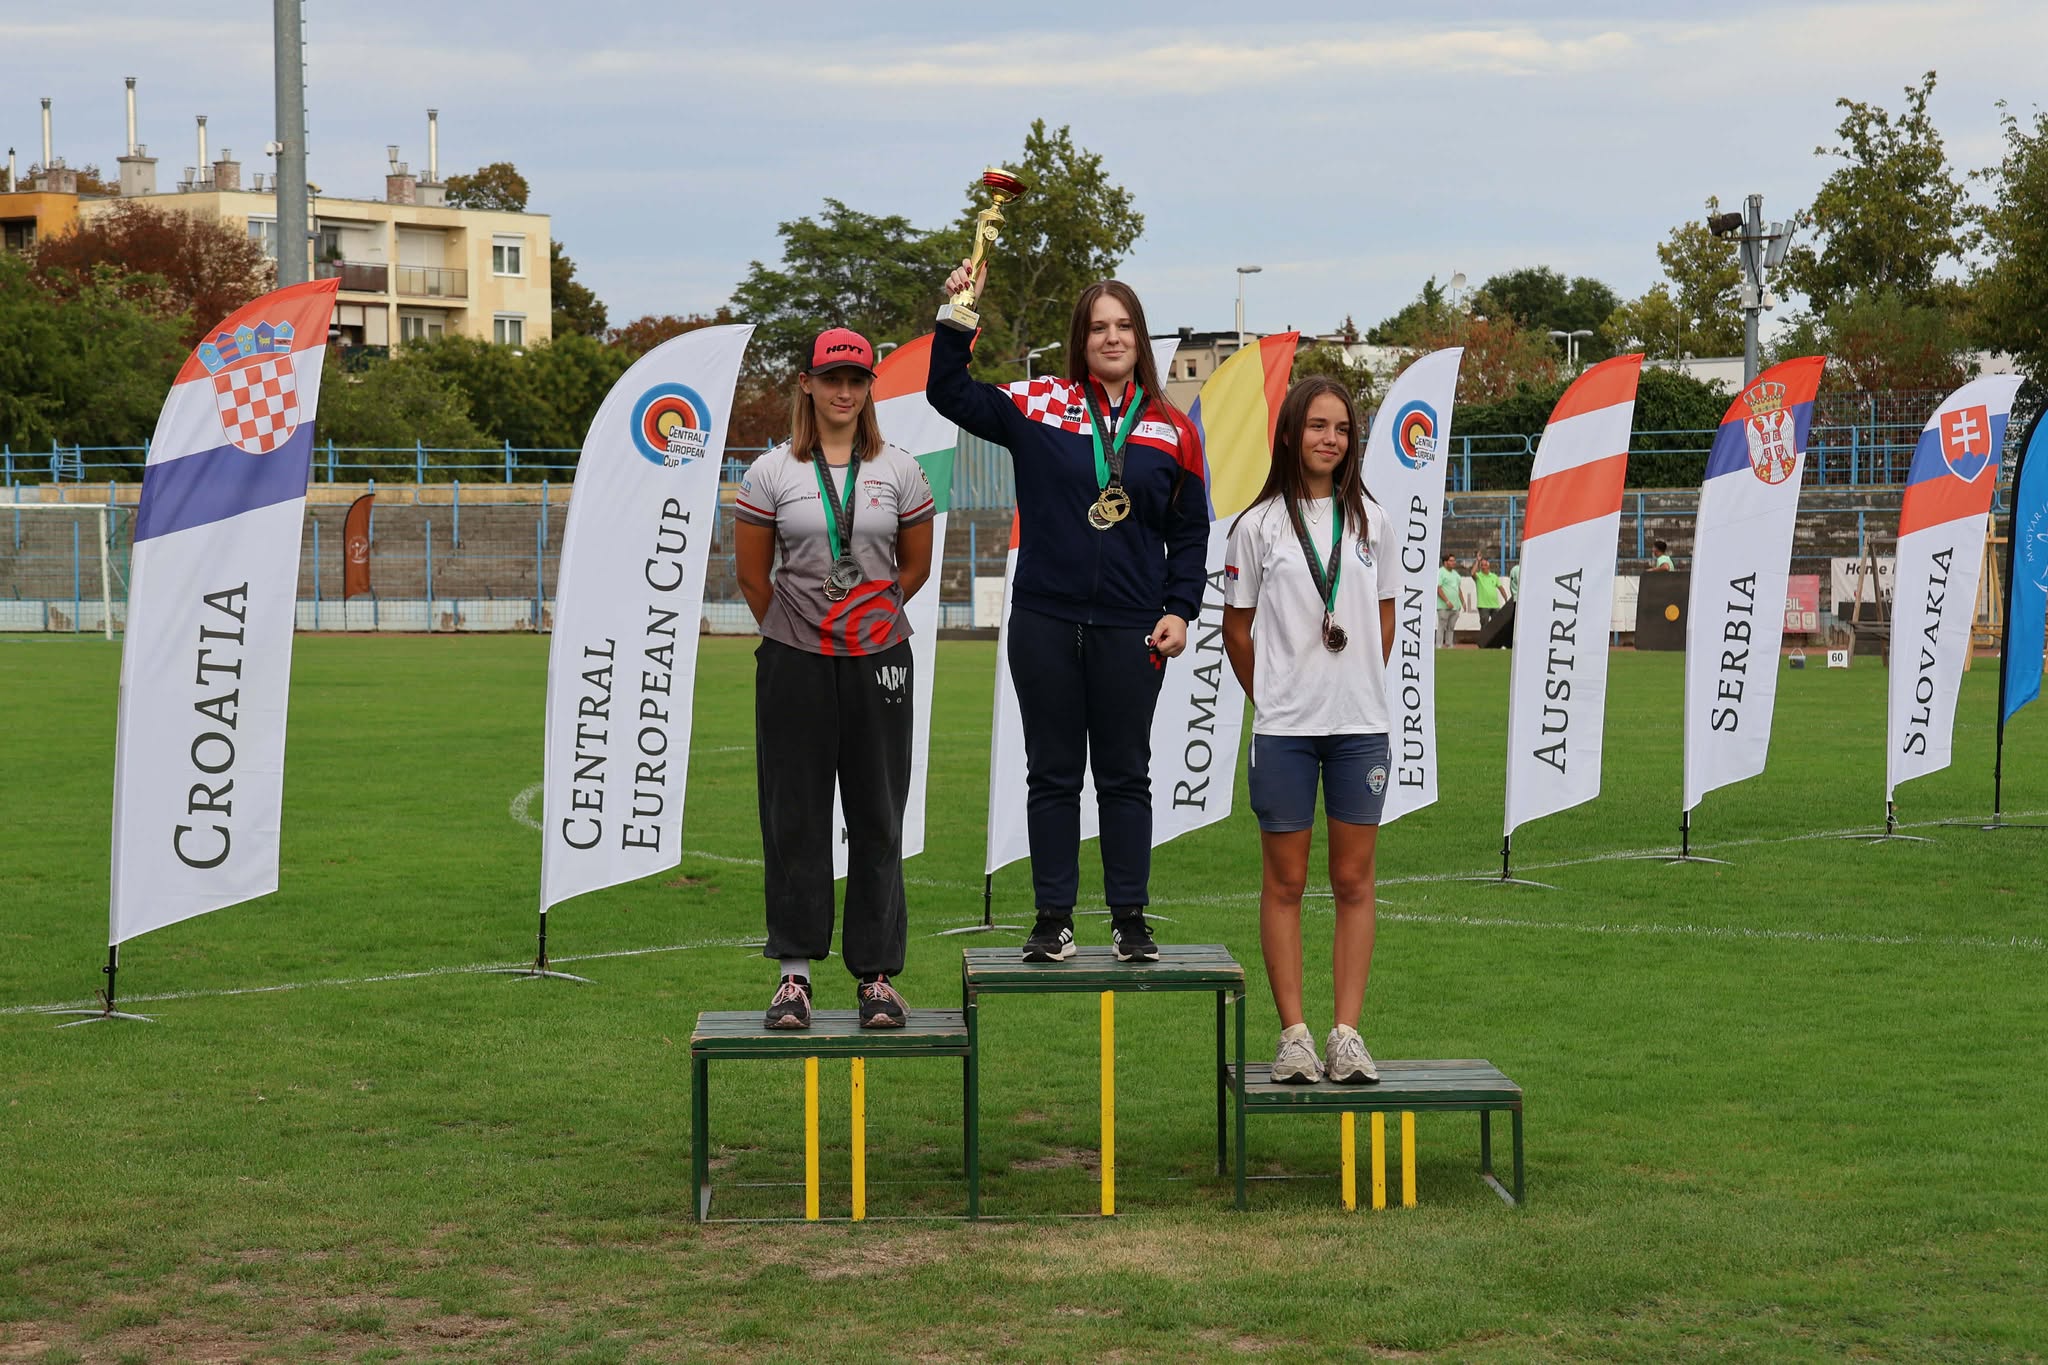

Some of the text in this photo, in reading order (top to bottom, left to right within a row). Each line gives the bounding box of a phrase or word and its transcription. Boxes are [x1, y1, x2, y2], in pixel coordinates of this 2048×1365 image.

[669, 425, 703, 443] CENTRAL
[826, 344, 864, 355] HOYT
[663, 454, 680, 469] CUP
[665, 440, 705, 459] EUROPEAN
[2026, 512, 2042, 562] MAGYAR
[173, 581, 249, 870] CROATIA
[622, 497, 691, 853] EUROPEAN CUP
[1172, 569, 1226, 812] ROMANIA
[1398, 495, 1428, 790] EUROPEAN CUP
[1532, 567, 1583, 775] AUSTRIA
[1710, 571, 1757, 733] SERBIA
[1831, 652, 1843, 662] 60
[1902, 546, 1954, 756] SLOVAKIA
[563, 638, 616, 850] CENTRAL
